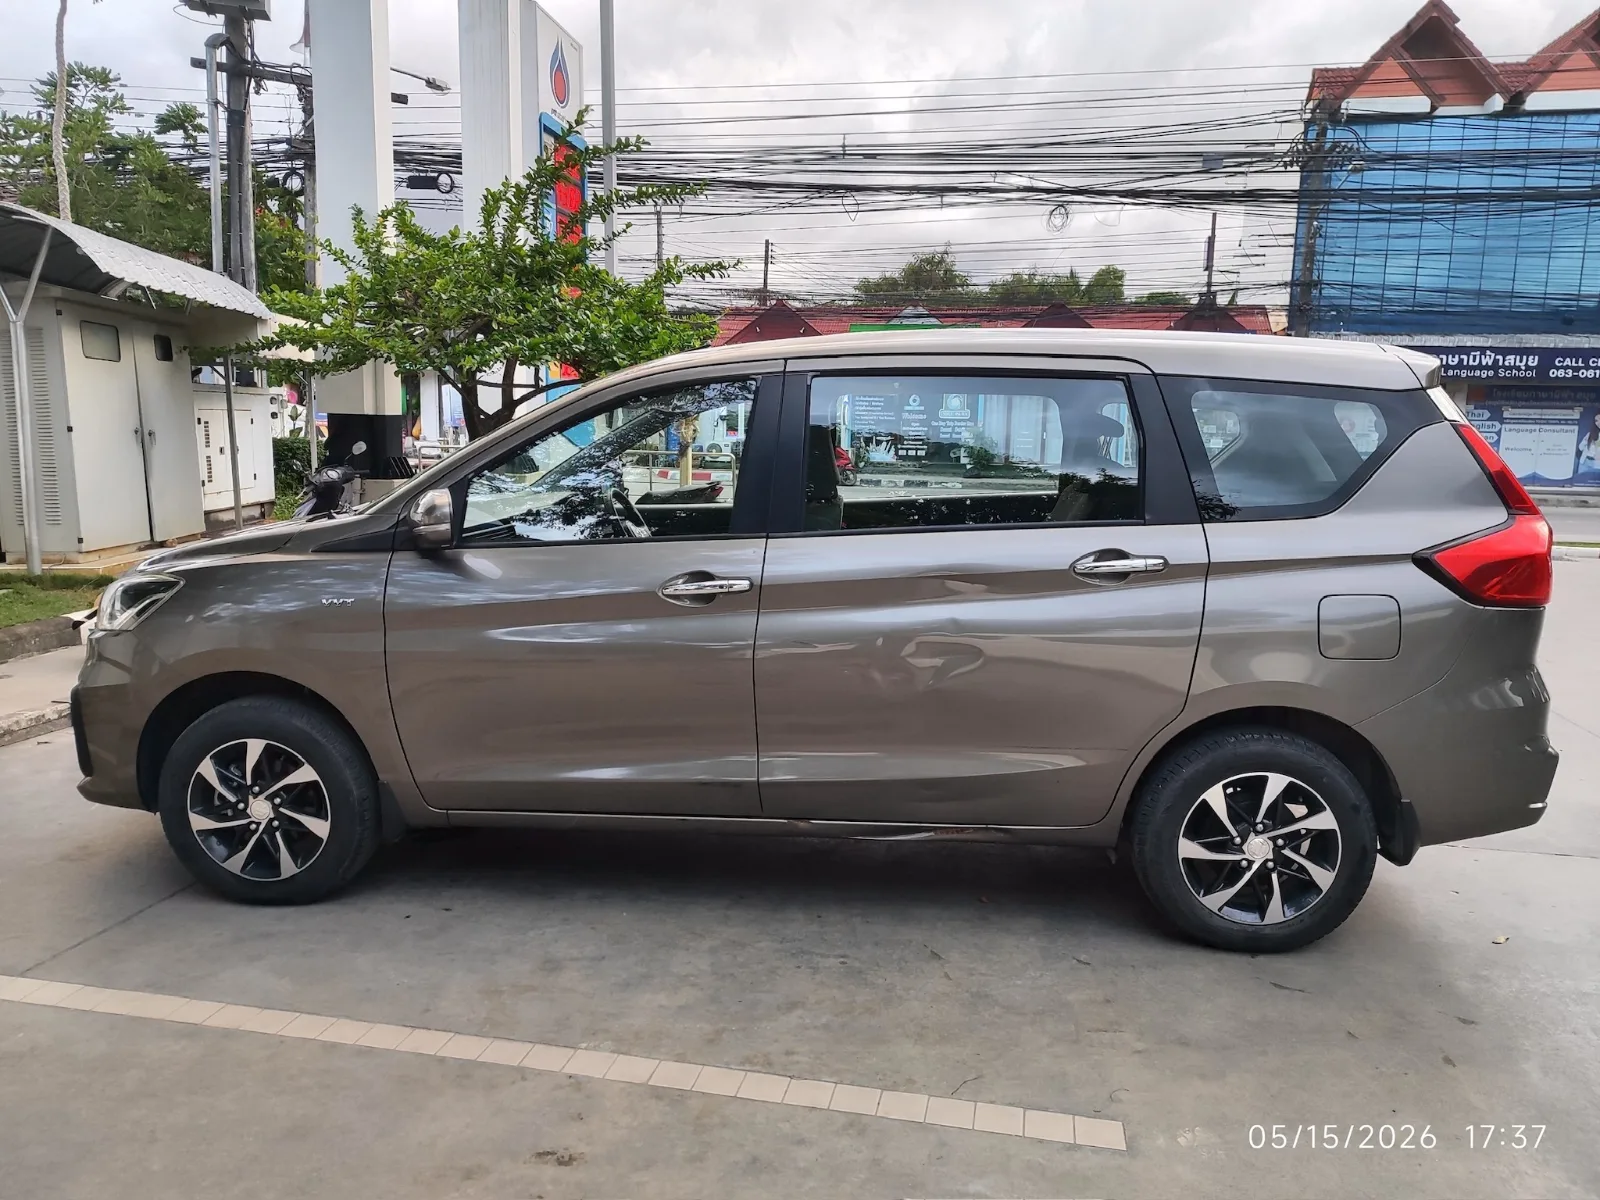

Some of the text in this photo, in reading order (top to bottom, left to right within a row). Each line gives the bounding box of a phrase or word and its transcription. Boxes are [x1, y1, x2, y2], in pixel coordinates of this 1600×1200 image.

[1438, 350, 1538, 369] าษามีฟ้าสมุย
[1554, 358, 1585, 367] CALL
[1441, 367, 1536, 378] Language School
[1549, 369, 1600, 378] 063-061
[1474, 422, 1497, 431] glish
